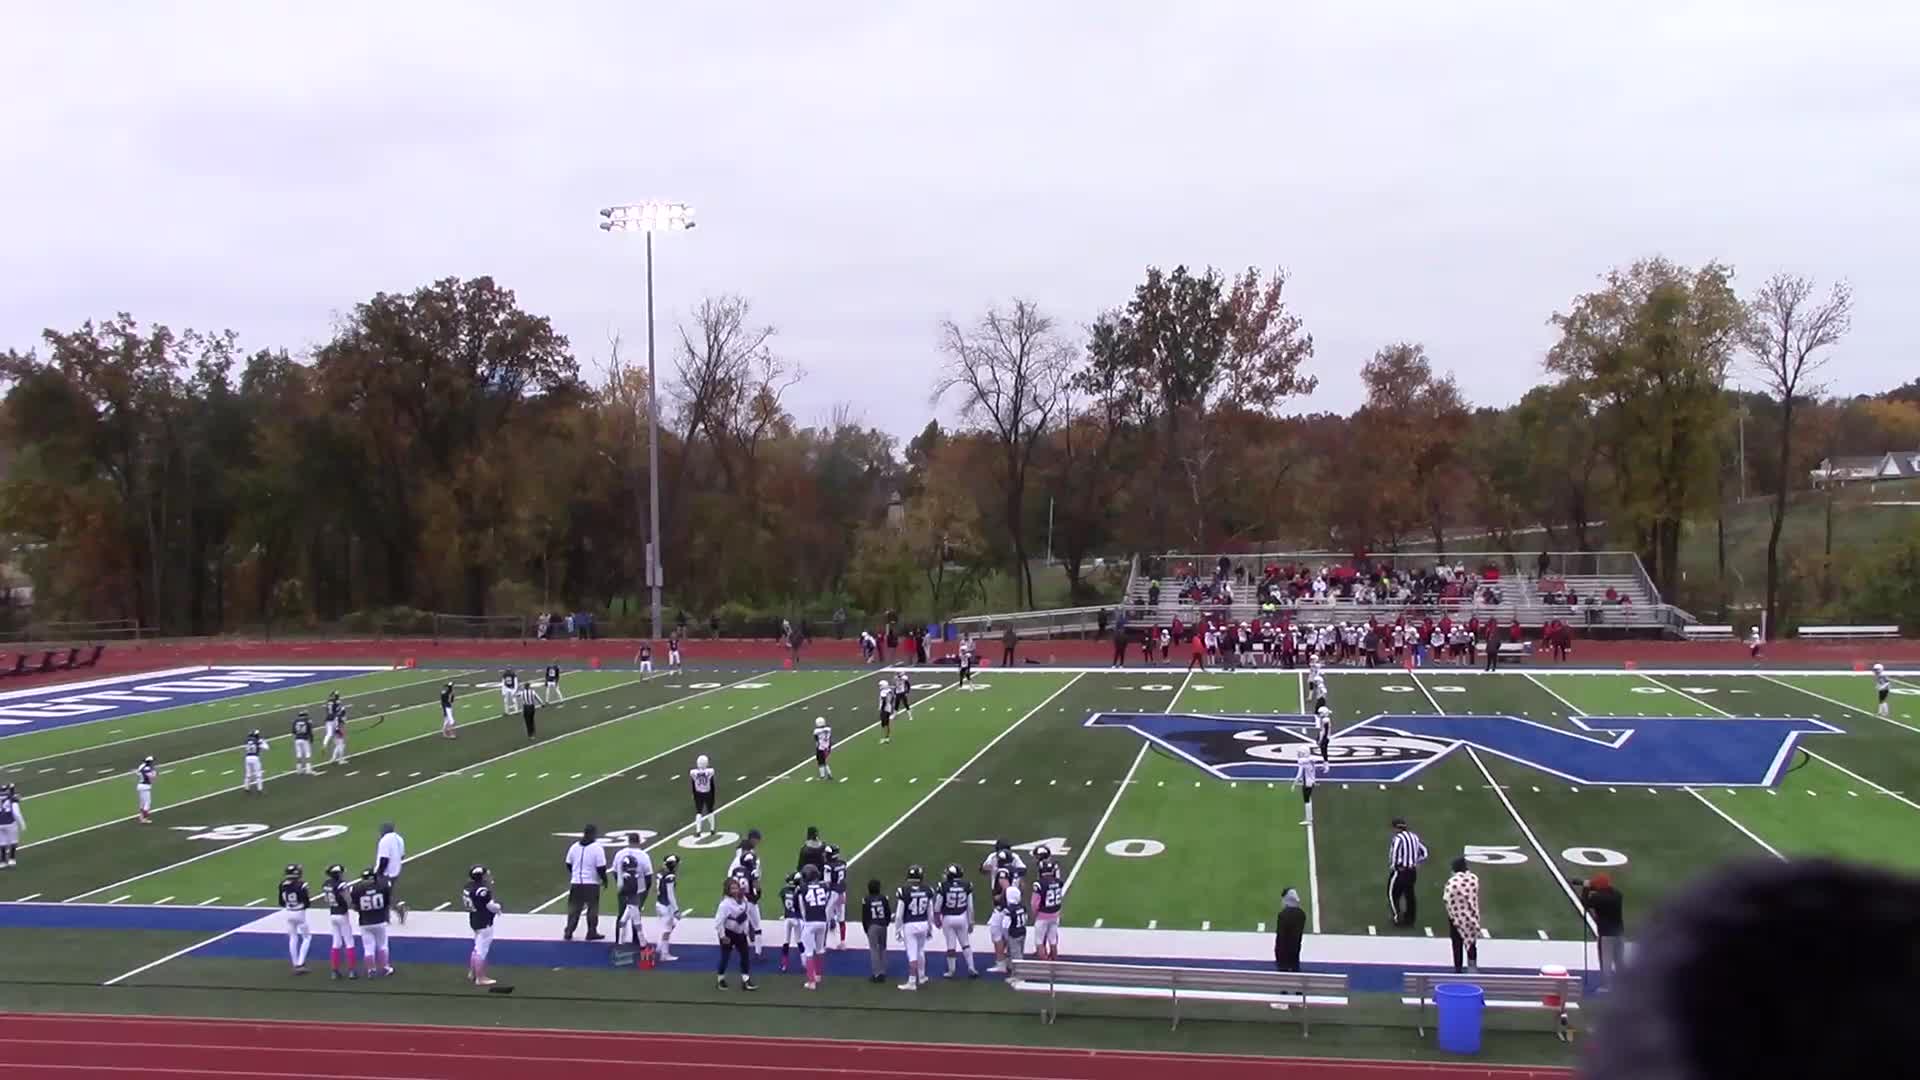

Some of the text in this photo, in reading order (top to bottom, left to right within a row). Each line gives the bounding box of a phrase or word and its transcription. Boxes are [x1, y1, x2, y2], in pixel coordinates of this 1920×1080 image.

[0, 671, 317, 726] GTON
[359, 893, 385, 911] 60
[805, 888, 827, 906] 42
[1045, 889, 1062, 907] 22
